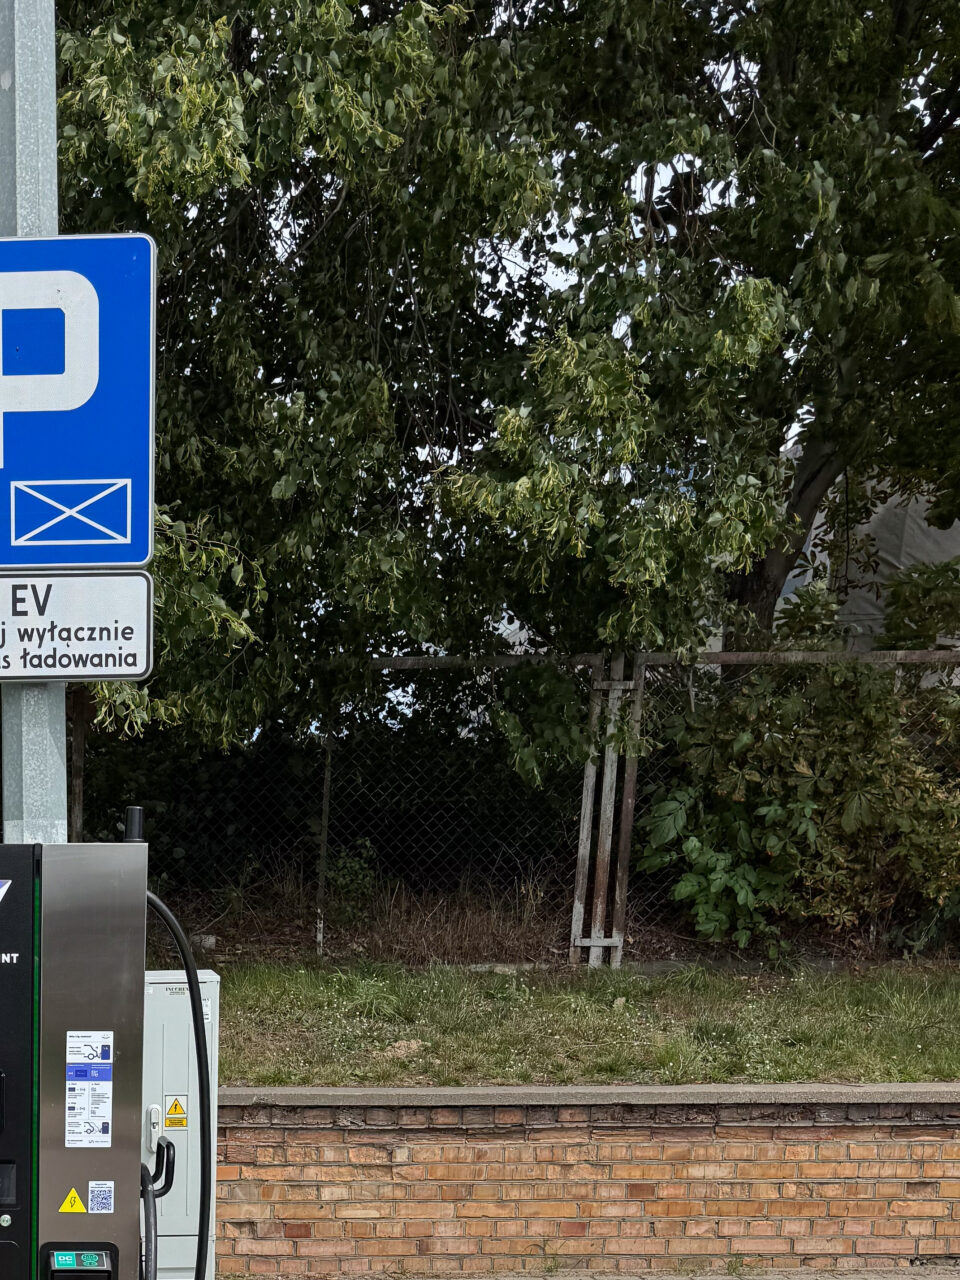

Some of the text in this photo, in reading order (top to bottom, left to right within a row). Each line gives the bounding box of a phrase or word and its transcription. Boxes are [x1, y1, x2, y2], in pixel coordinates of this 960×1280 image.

[11, 583, 53, 617] EV
[17, 619, 135, 649] wyłącznie
[20, 646, 138, 669] ładowania
